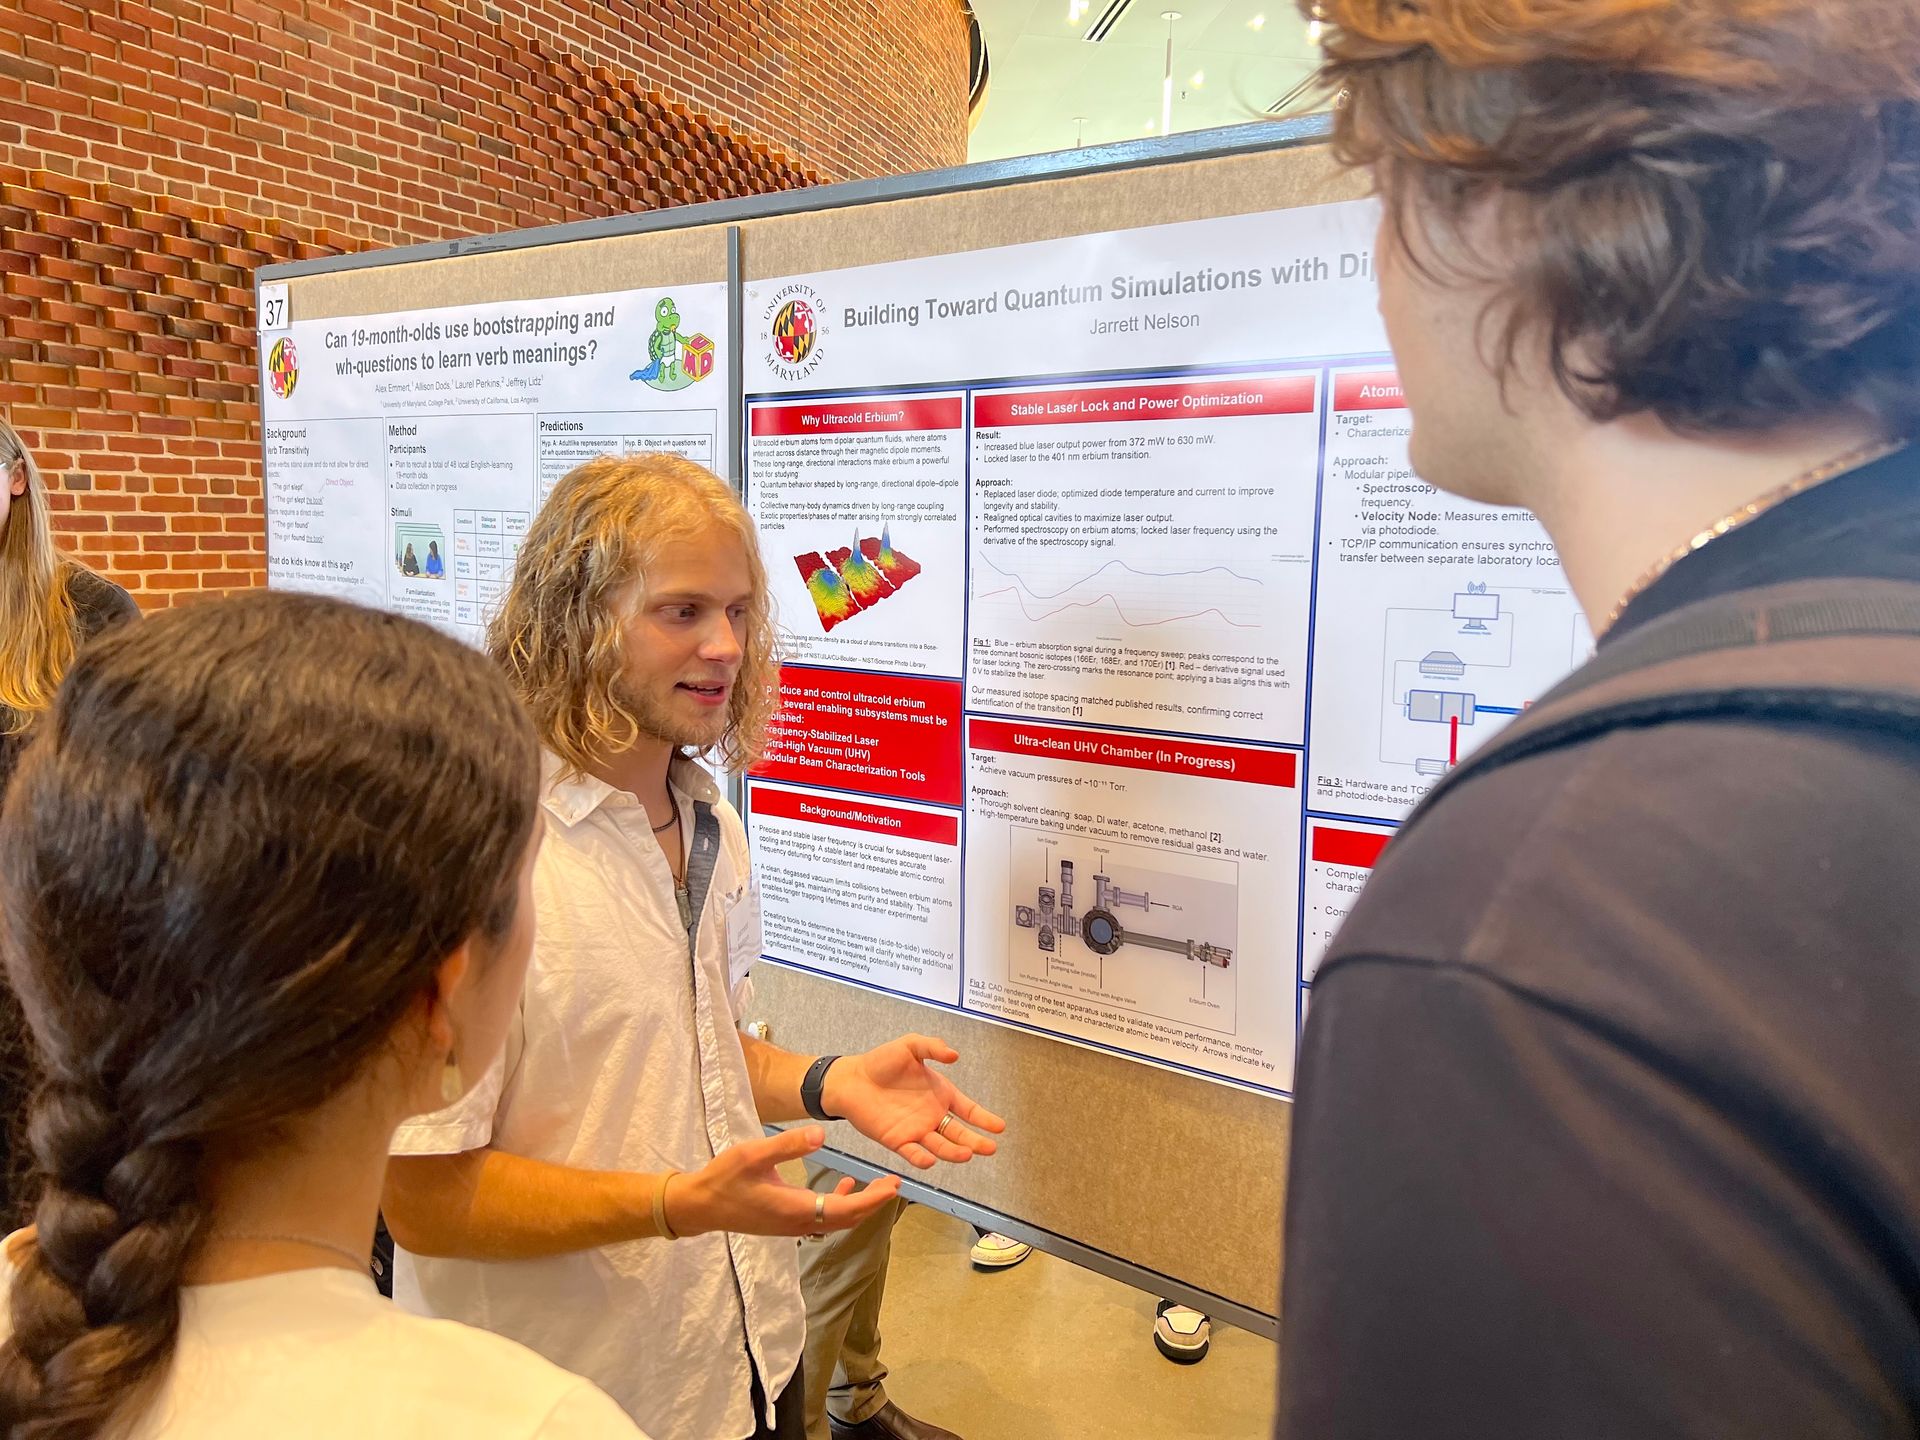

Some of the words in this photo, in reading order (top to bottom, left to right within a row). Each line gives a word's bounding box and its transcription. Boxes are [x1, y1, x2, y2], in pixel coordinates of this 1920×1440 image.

[844, 303, 919, 328] Building
[925, 291, 997, 319] Toward
[1004, 284, 1102, 312] Quantum
[1111, 268, 1262, 300] Simulations
[1271, 256, 1328, 285] with
[1339, 249, 1374, 282] Di
[764, 284, 816, 320] UNIVERSITY
[816, 298, 826, 314] OF
[266, 300, 284, 326] 37
[325, 331, 347, 349] Can
[351, 322, 441, 347] 19-month-olds
[445, 323, 469, 339] use
[473, 310, 579, 337] bootstrapping
[584, 306, 615, 328] and
[1090, 316, 1139, 334] Jarrett
[1144, 312, 1199, 330] Nelson
[335, 354, 417, 378] wh-questions
[421, 352, 434, 370] to
[439, 350, 471, 369] learn
[475, 346, 508, 366] verb
[513, 339, 597, 366] meanings?
[764, 348, 824, 381] MARYLAND
[1360, 385, 1404, 398] Atom
[1011, 403, 1044, 416] Stable
[1047, 402, 1078, 414] Laser
[1081, 400, 1109, 412] Lock
[1113, 398, 1135, 411] and
[1139, 398, 1179, 409] Power
[1182, 391, 1264, 408] Optimization
[801, 415, 820, 427] Why
[823, 412, 862, 424] Ultracold
[865, 409, 905, 424] Erbium?
[1336, 414, 1372, 426] Target:
[388, 424, 417, 436] Method
[540, 420, 584, 432] Predictions
[267, 428, 306, 440] Background
[976, 430, 1002, 440] Result:
[390, 444, 426, 455] Participants
[984, 442, 1018, 451] Increased
[1019, 442, 1035, 450] blue
[1036, 441, 1055, 450] laser
[1056, 440, 1080, 450] output
[1082, 440, 1107, 450] power
[1108, 438, 1127, 447] from
[1129, 437, 1145, 447] 372
[1147, 436, 1165, 446] mW
[1167, 437, 1176, 445] to
[1177, 435, 1194, 445] 630
[1196, 434, 1215, 444] mW.
[984, 454, 1009, 463] Locked
[1010, 454, 1028, 463] laser
[1029, 454, 1037, 462] to
[1038, 453, 1050, 462] the
[1051, 452, 1065, 461] 401
[1082, 451, 1109, 460] erbium
[1110, 450, 1151, 460] transition.
[1333, 456, 1388, 467] Approach:
[976, 478, 1013, 488] Approach:
[1362, 484, 1438, 494] Spectroscopy
[1362, 498, 1414, 508] frequency.
[391, 508, 412, 517] Stimuli
[1361, 511, 1405, 523] Velocity
[1408, 511, 1441, 521] Node:
[1444, 511, 1498, 521] Measures
[1501, 511, 1536, 521] emitte
[1361, 525, 1376, 535] via
[1379, 525, 1439, 537] photodiode.
[1340, 538, 1376, 548] TCP/IP
[1379, 540, 1458, 550] communication
[1461, 542, 1505, 550] ensures
[1508, 540, 1554, 553] synchro
[1340, 552, 1378, 562] transfer
[1380, 553, 1424, 563] between
[1427, 555, 1474, 566] separate
[1477, 554, 1533, 568] laboratory
[1536, 554, 1561, 566] loca
[766, 685, 802, 696] pduce
[803, 688, 819, 697] and
[821, 690, 851, 701] control
[853, 692, 891, 705] ultracold
[894, 697, 925, 709] erbium
[784, 700, 815, 711] several
[816, 703, 853, 717] enabling
[855, 707, 908, 722] subsystems
[910, 715, 934, 725] must
[936, 715, 948, 726] be
[854, 734, 879, 746] Laser
[807, 742, 842, 756] Vacuum
[845, 747, 870, 762] (UHV)
[971, 753, 996, 764] Target:
[1014, 734, 1070, 750] Ultra-clean
[1074, 740, 1098, 753] UHV
[1101, 744, 1153, 760] Chamber
[1156, 750, 1171, 764] (In
[1175, 752, 1235, 773] Progress)
[763, 751, 798, 764] Modular
[799, 755, 823, 767] Beam
[825, 759, 898, 778] Characterization
[900, 768, 926, 782] Tools
[979, 765, 1007, 776] Achieve
[1008, 770, 1036, 779] vacuum
[1037, 774, 1073, 785] pressures
[1074, 777, 1082, 786] of
[1109, 781, 1127, 792] Torr.
[972, 786, 1008, 799] Approach:
[1411, 785, 1432, 798] TCP
[800, 802, 902, 828] Background/Motivation
[1326, 868, 1368, 883] Complet
